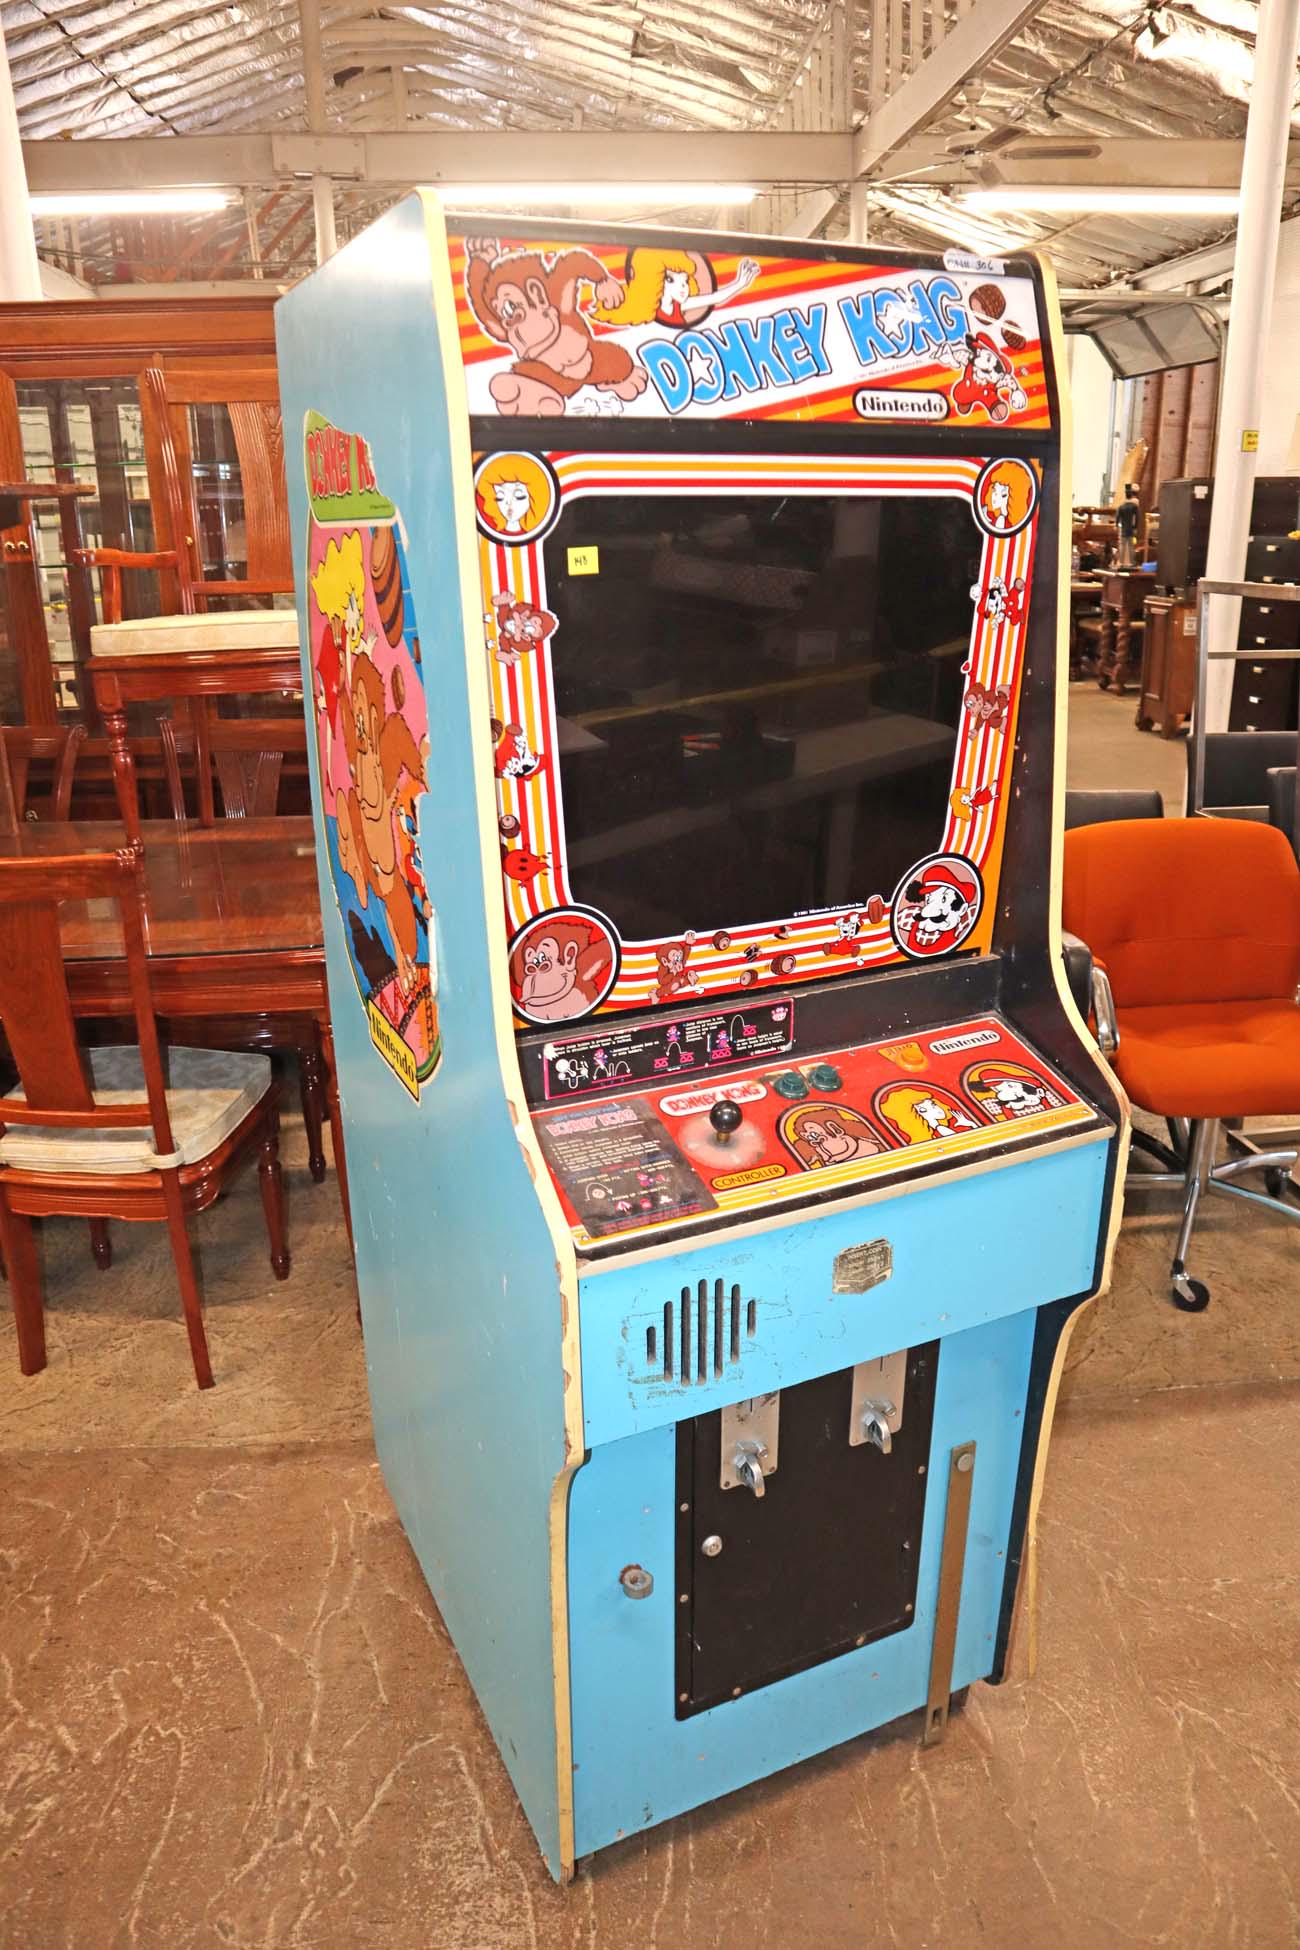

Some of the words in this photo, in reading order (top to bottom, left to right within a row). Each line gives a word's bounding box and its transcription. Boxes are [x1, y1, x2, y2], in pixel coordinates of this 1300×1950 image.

[638, 303, 832, 415] DONKEY
[838, 277, 968, 367] KONG
[861, 396, 943, 413] Nintendo
[371, 1011, 415, 1082] Nintendo
[932, 1033, 998, 1052] Nintendo
[666, 1092, 718, 1112] DONKEY
[714, 1166, 782, 1187] CONTROLLER
